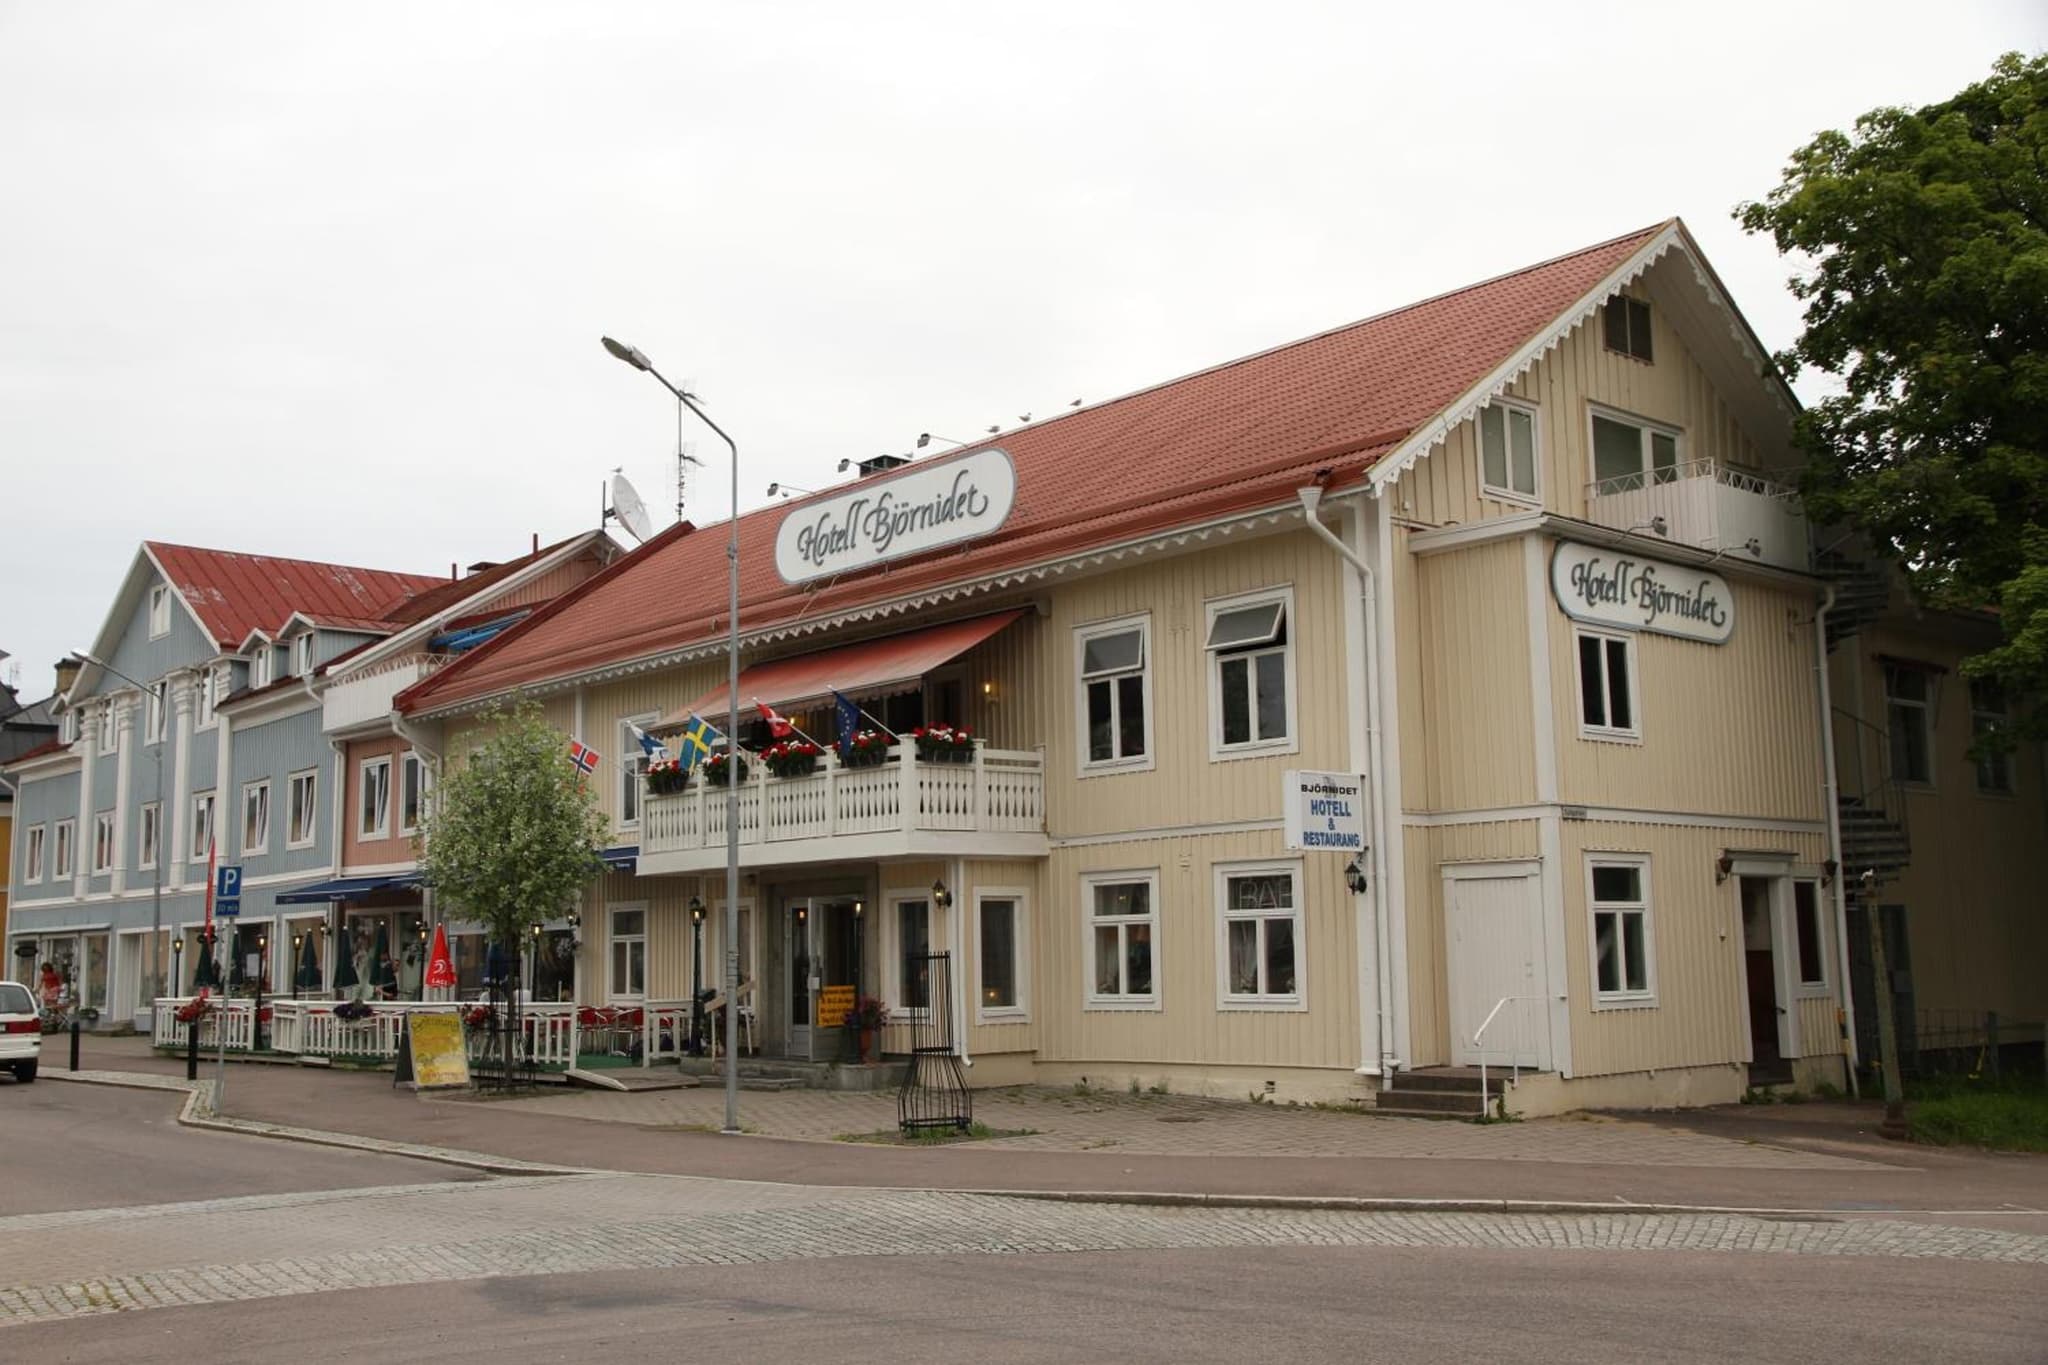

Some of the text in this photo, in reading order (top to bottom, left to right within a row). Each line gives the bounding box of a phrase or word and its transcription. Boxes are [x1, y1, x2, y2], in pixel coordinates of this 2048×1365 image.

[797, 470, 988, 566] Hotell Björnidet
[1572, 558, 1725, 627] Hotell Björnidet
[1301, 784, 1358, 795] BJÖRNIDET
[1311, 799, 1352, 817] HOTELL
[1328, 817, 1336, 830] &
[1303, 831, 1360, 848] RESTAURANG
[223, 869, 237, 894] P
